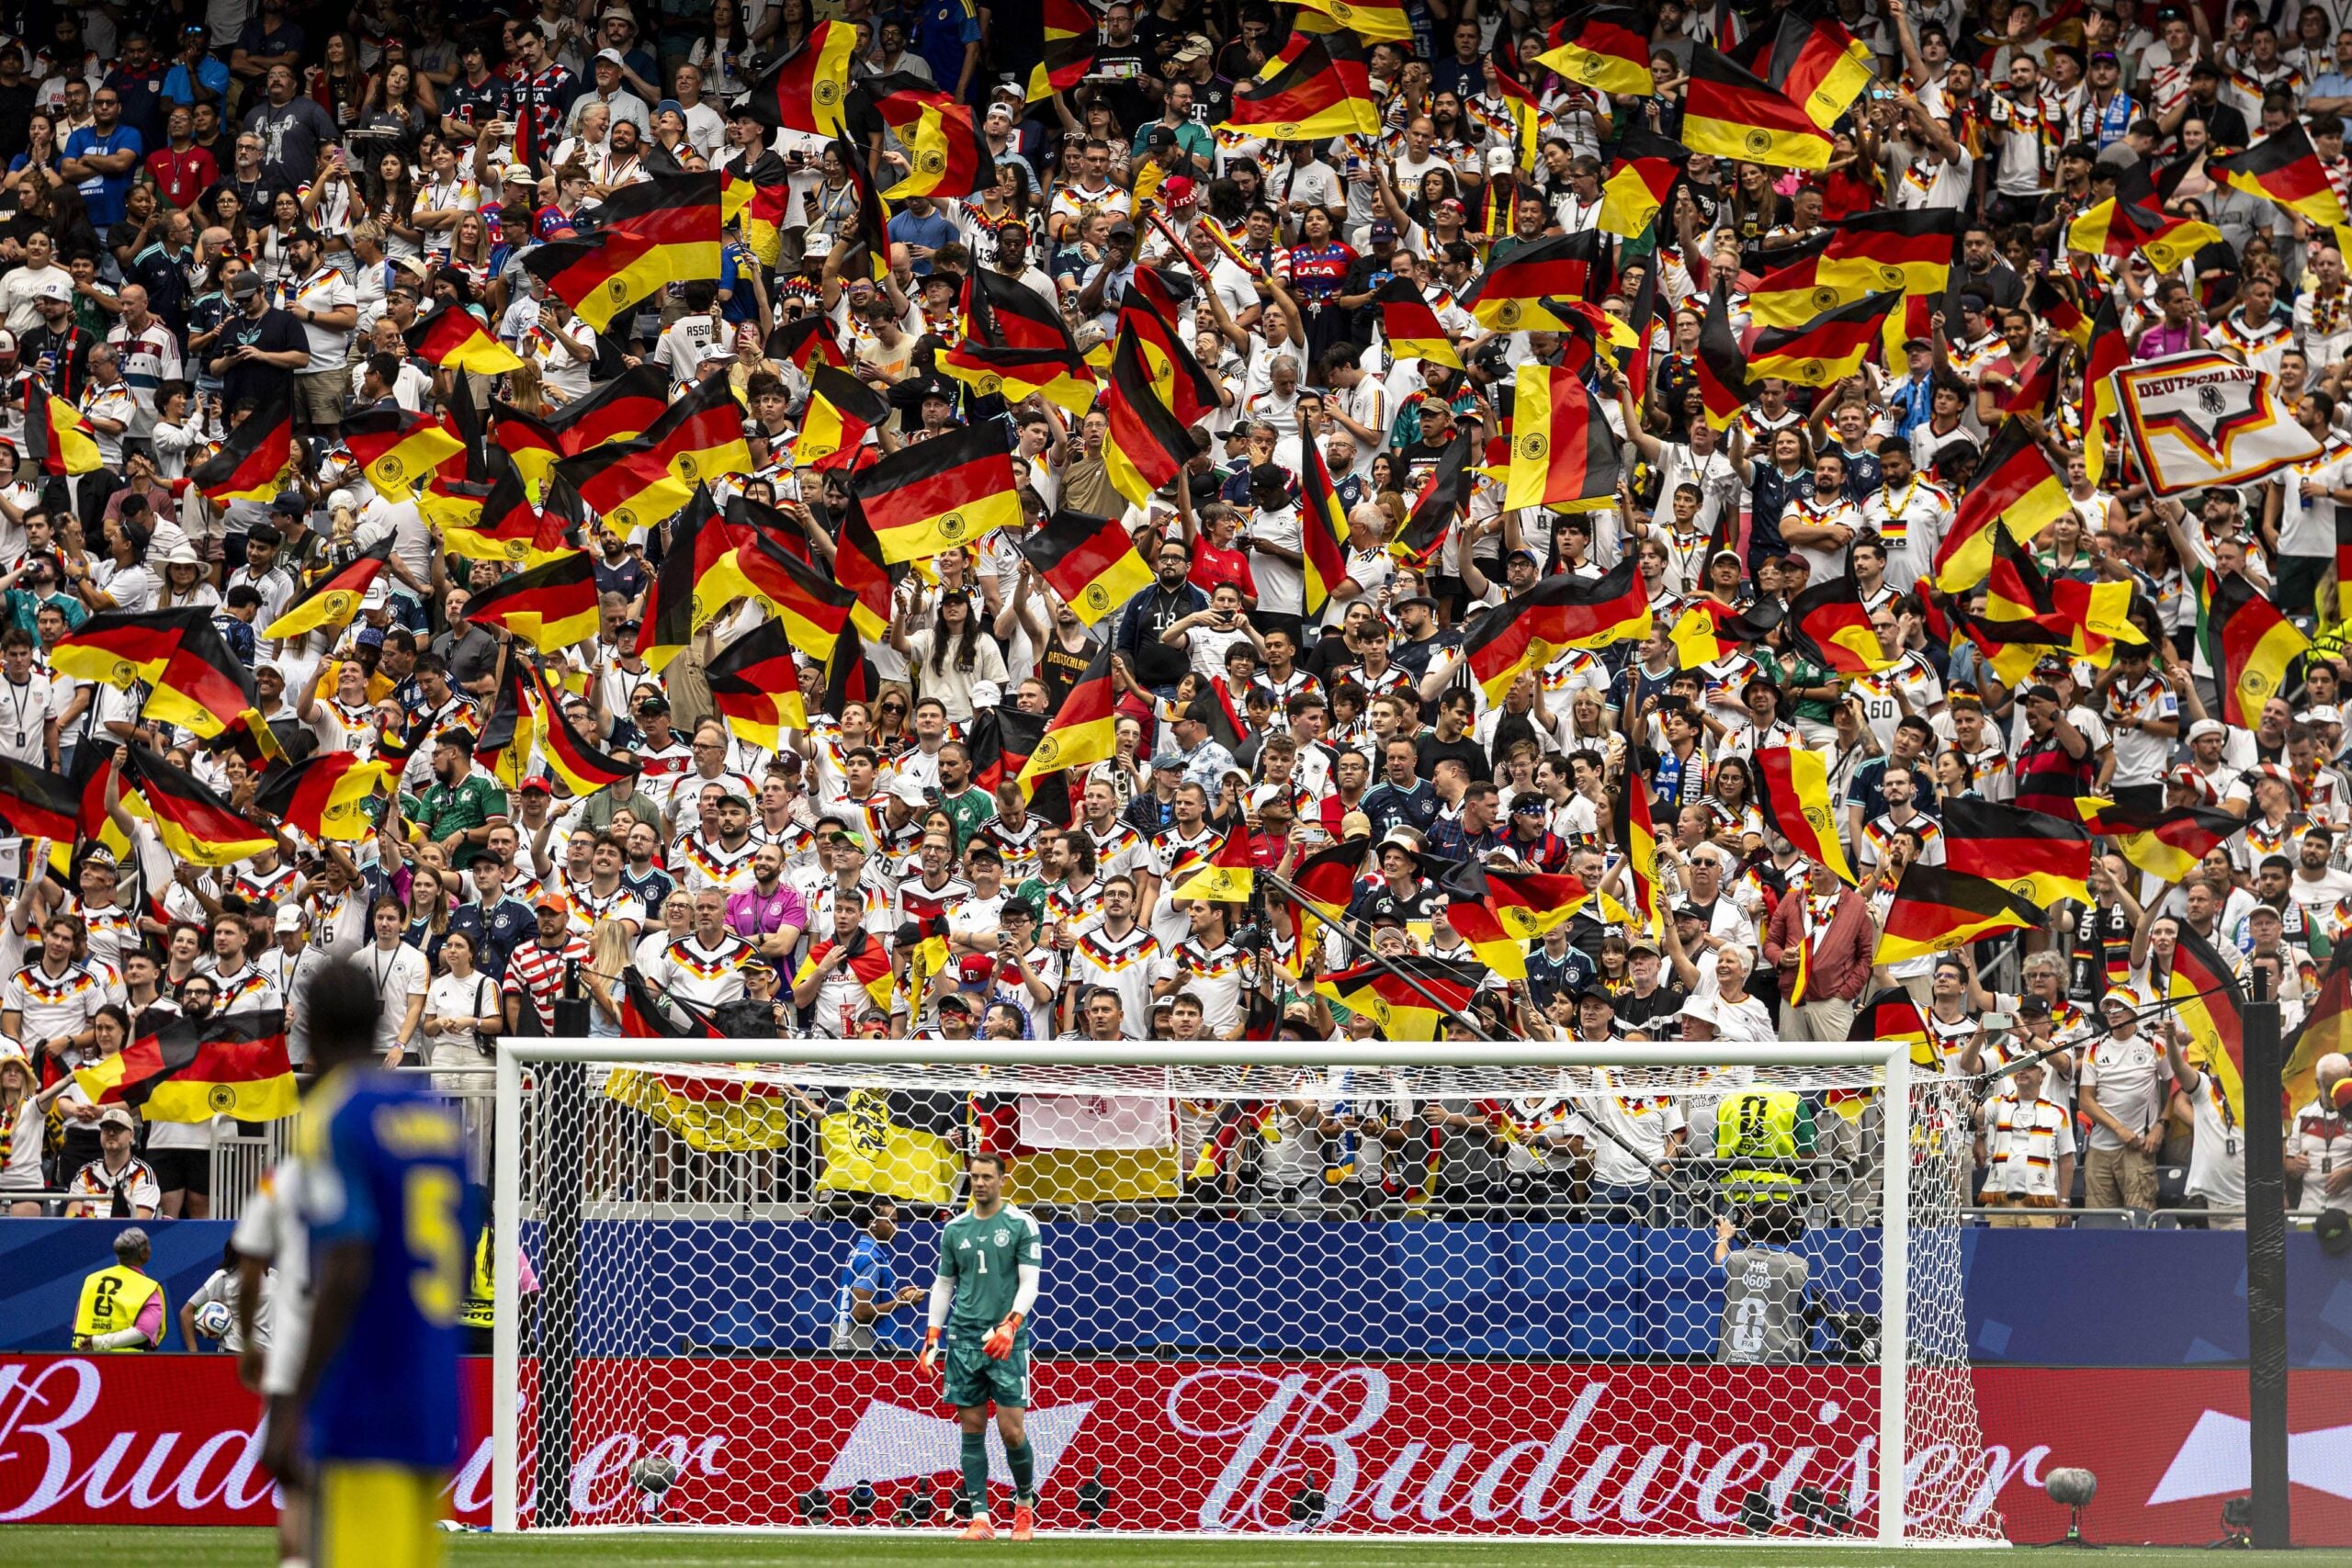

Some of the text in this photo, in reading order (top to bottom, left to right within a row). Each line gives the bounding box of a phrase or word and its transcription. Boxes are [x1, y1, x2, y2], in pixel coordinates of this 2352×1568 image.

[516, 93, 545, 103] UA
[1296, 266, 1335, 276] USA
[2137, 369, 2256, 399] DEUTSCHLAND
[1153, 613, 1176, 630] 18
[1871, 700, 1893, 719] 60
[644, 779, 658, 795] 21
[1682, 750, 1703, 806] GERMANY
[875, 852, 894, 877] 26
[1010, 863, 1029, 879] 17
[822, 974, 858, 984] HECK2
[1008, 990, 1020, 1003] 11
[402, 1165, 466, 1328] 5
[976, 1249, 989, 1274] 1
[1020, 1376, 1028, 1400] 1
[0, 1359, 727, 1521] Budier
[1166, 1367, 2052, 1531] Budweiser
